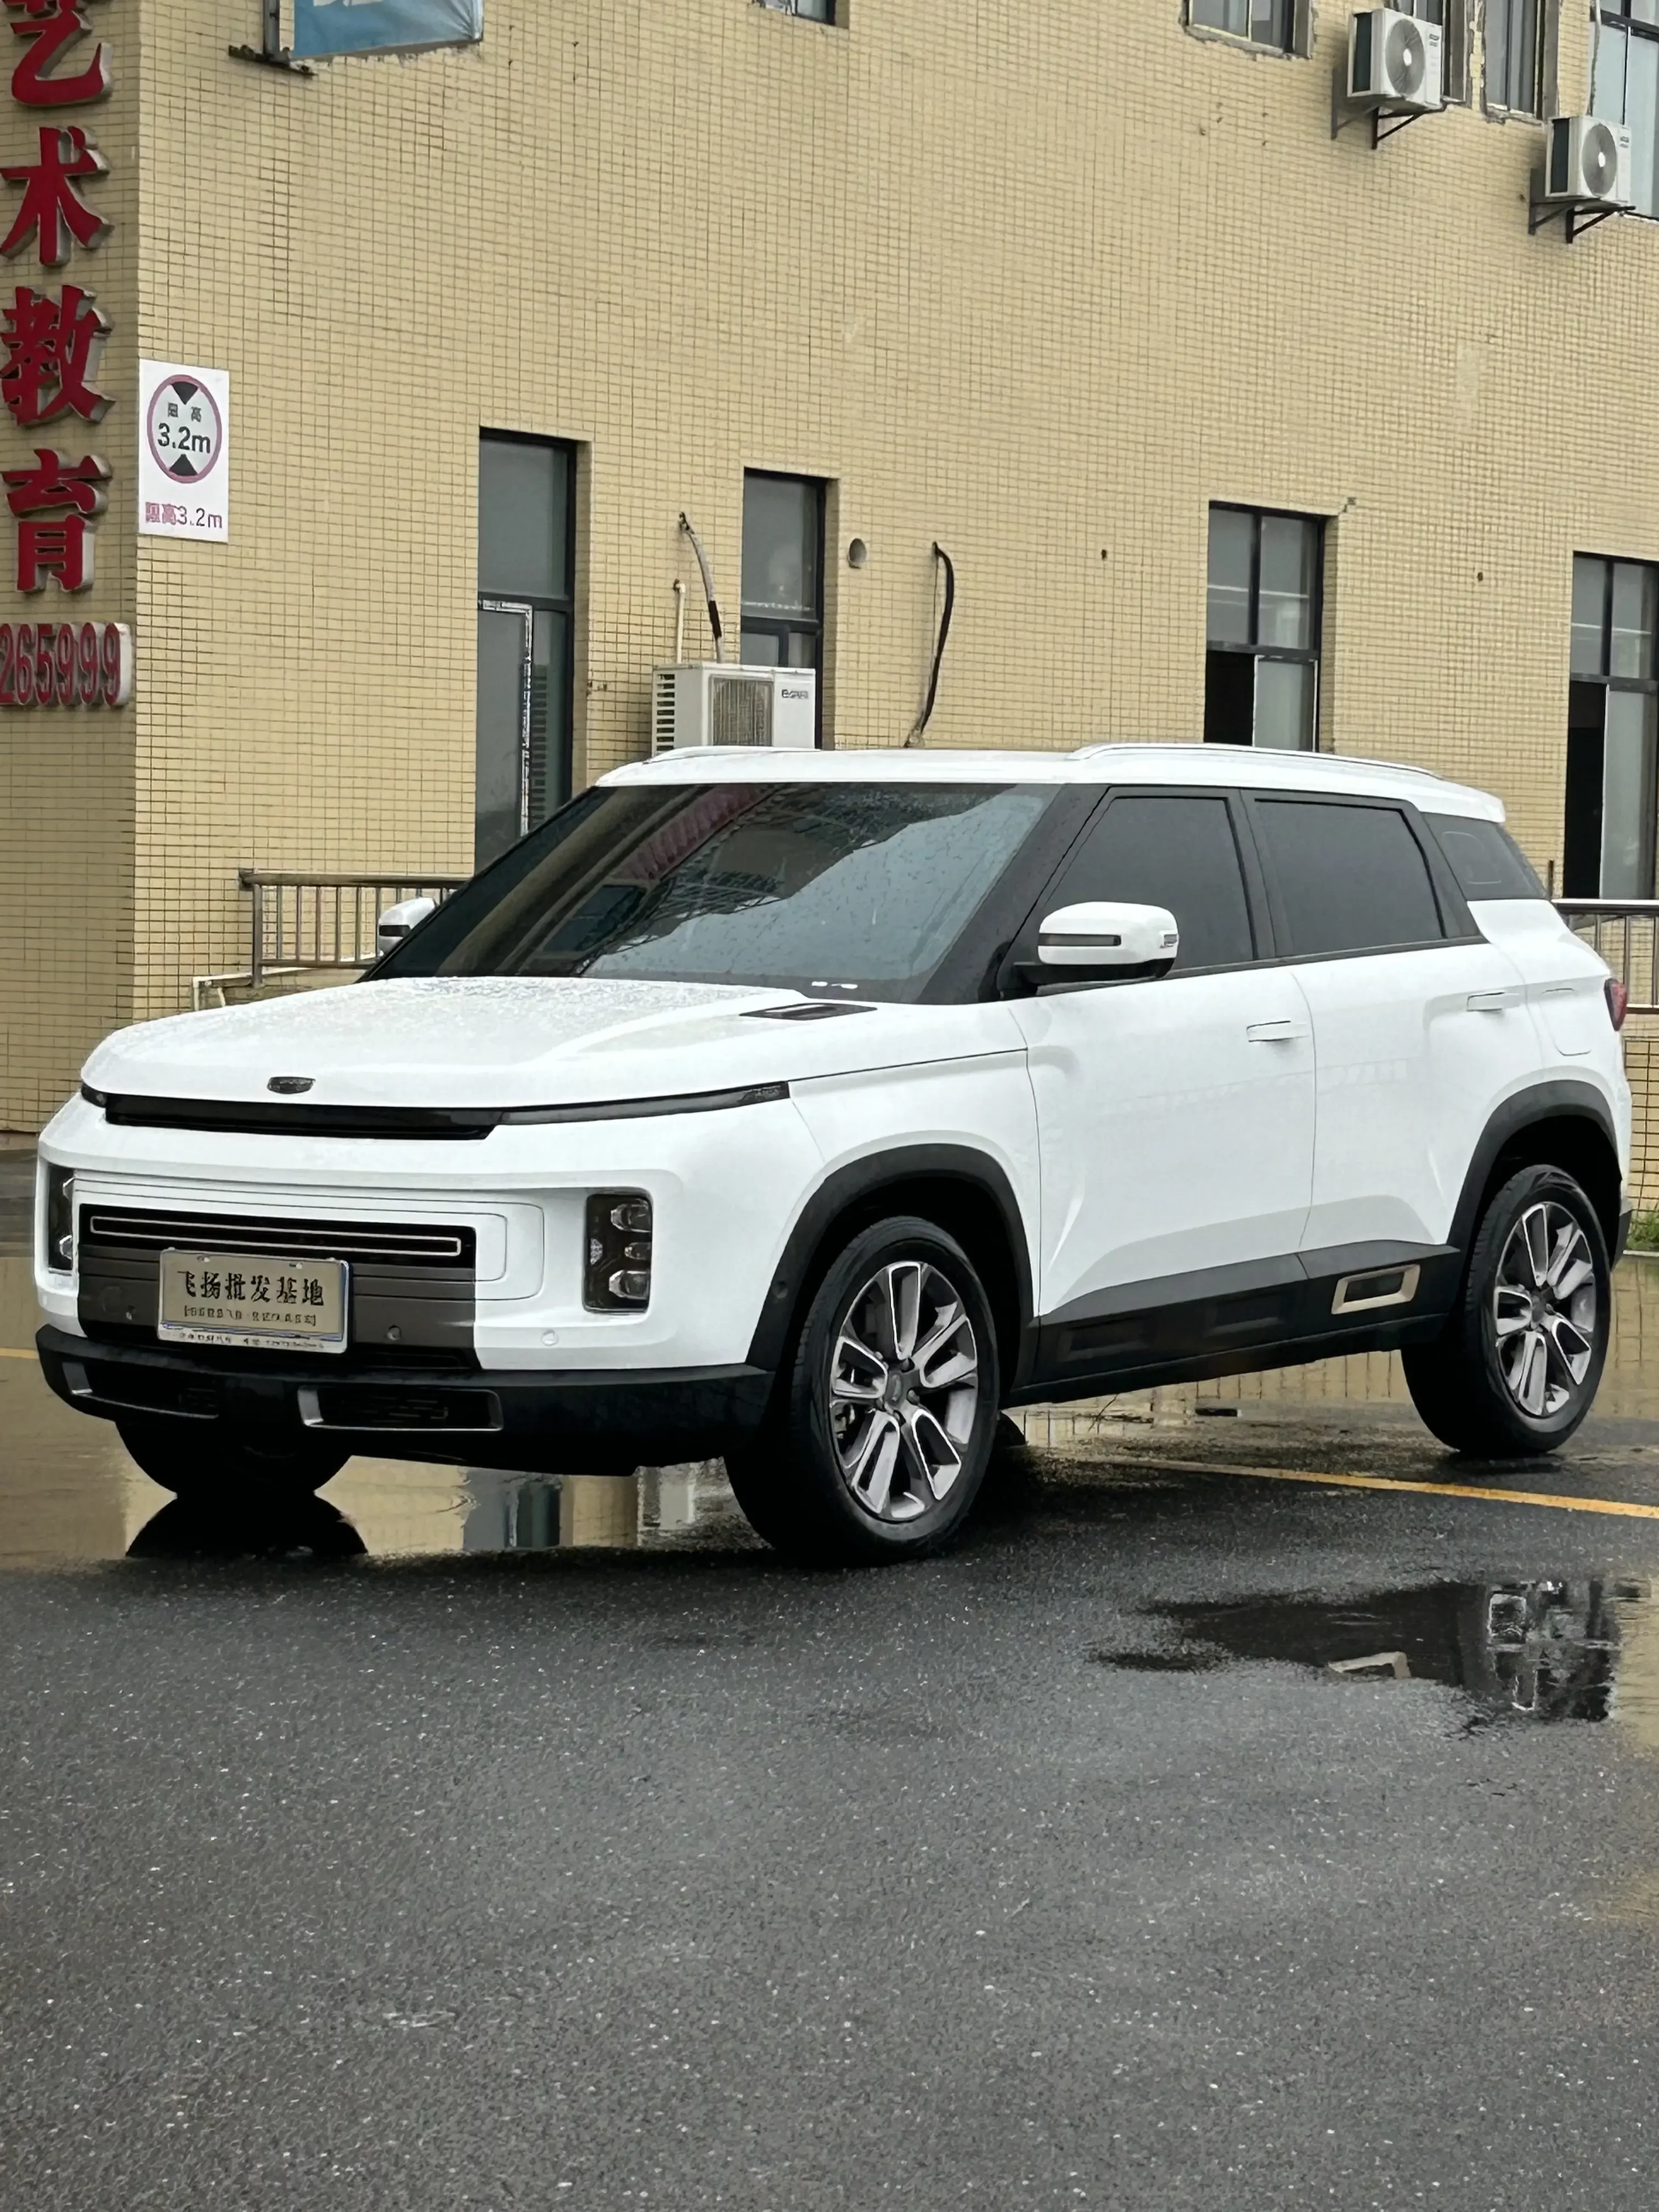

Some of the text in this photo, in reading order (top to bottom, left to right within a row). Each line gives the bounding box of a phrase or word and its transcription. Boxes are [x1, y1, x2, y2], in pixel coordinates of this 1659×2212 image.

[0, 0, 113, 592] 艺术教育
[157, 422, 211, 454] 3.2m
[0, 623, 122, 706] 265999
[178, 1270, 324, 1306] 飞扬批发基地
